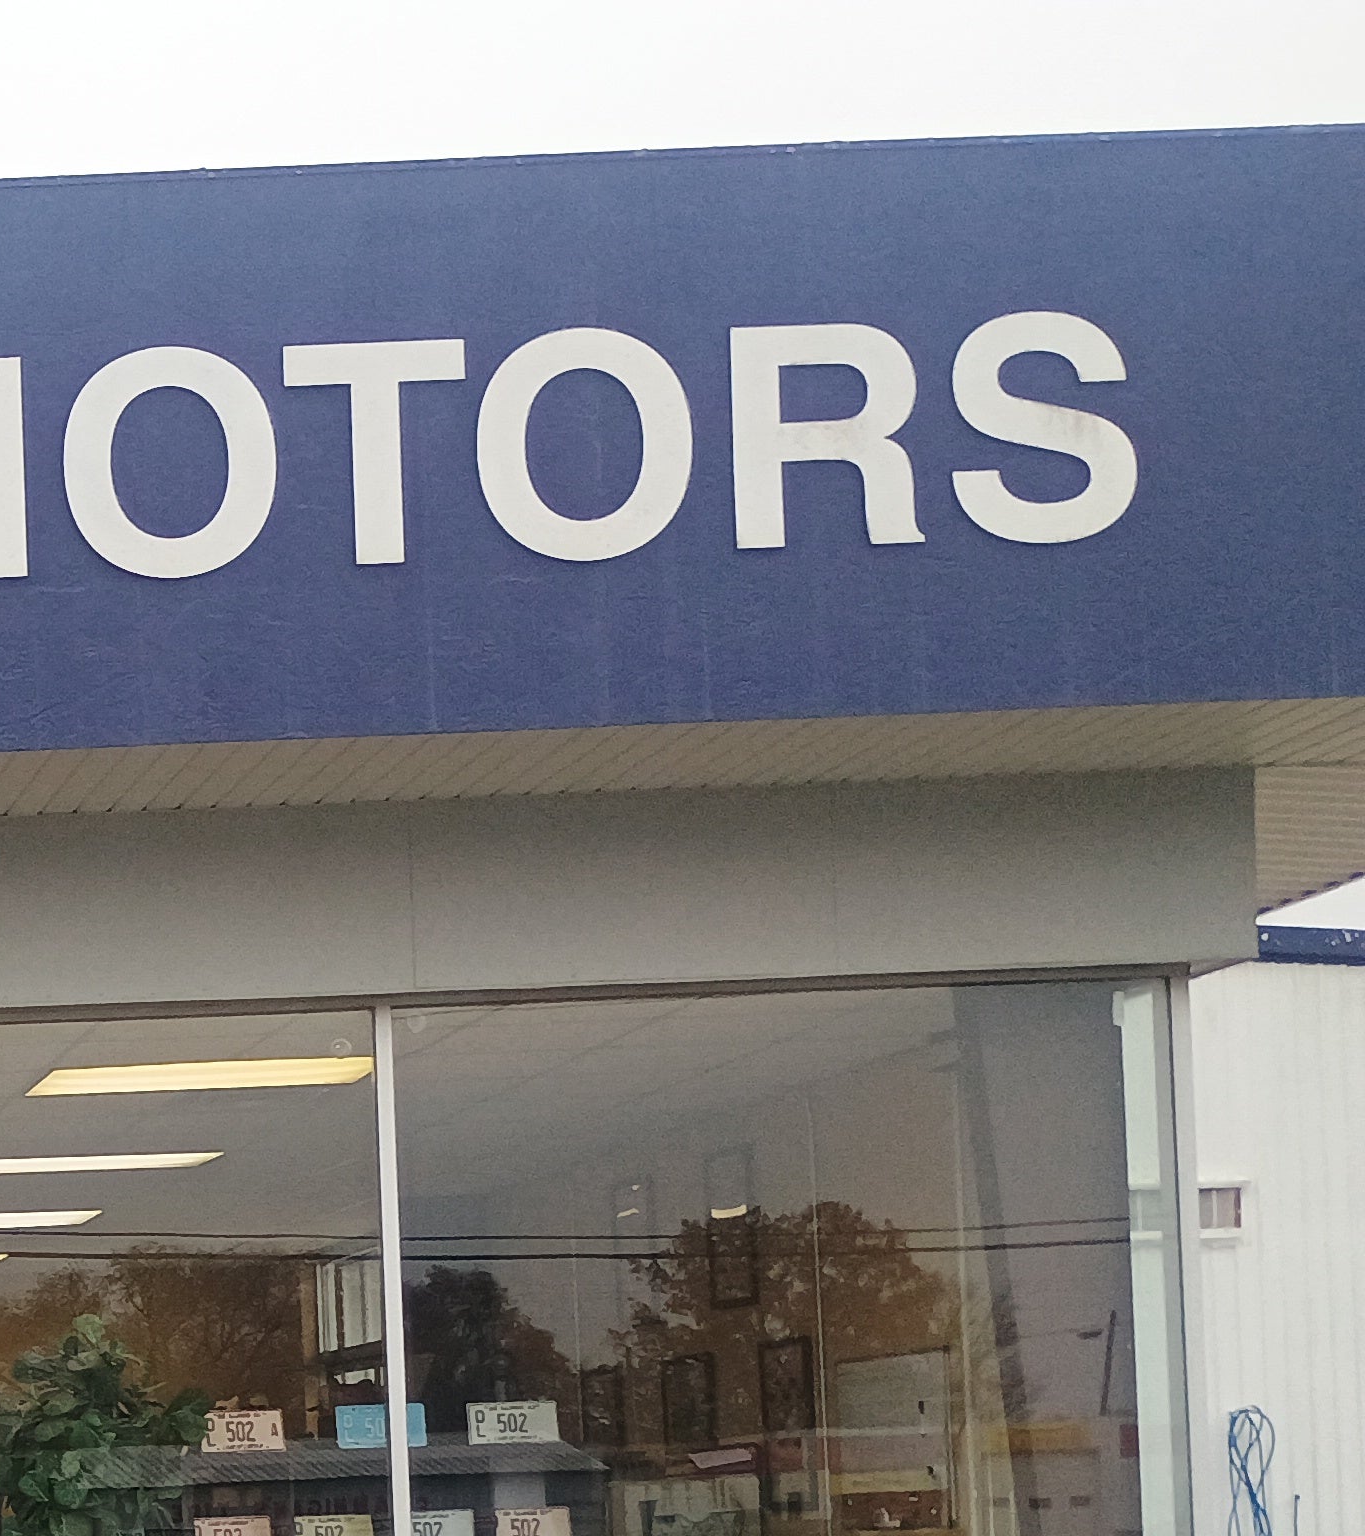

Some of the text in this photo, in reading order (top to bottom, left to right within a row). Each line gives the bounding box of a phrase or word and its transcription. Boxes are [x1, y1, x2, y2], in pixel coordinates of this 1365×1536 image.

[225, 1420, 256, 1443] 502
[365, 1417, 385, 1438] 50
[496, 1412, 528, 1433] 502
